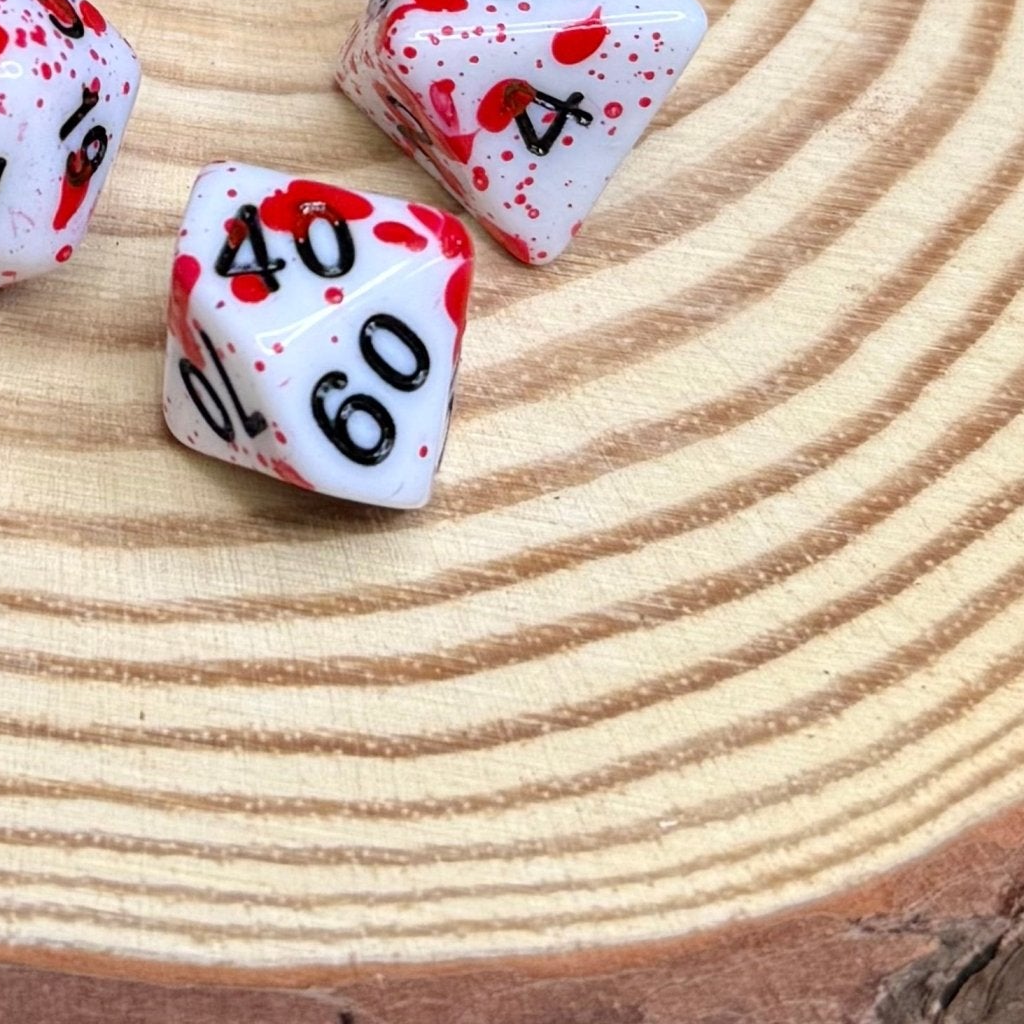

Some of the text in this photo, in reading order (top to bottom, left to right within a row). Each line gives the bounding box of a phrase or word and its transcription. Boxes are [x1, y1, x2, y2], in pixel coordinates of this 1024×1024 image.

[60, 83, 108, 186] 19
[501, 78, 594, 157] 4
[215, 200, 356, 292] 40
[311, 313, 431, 467] 60
